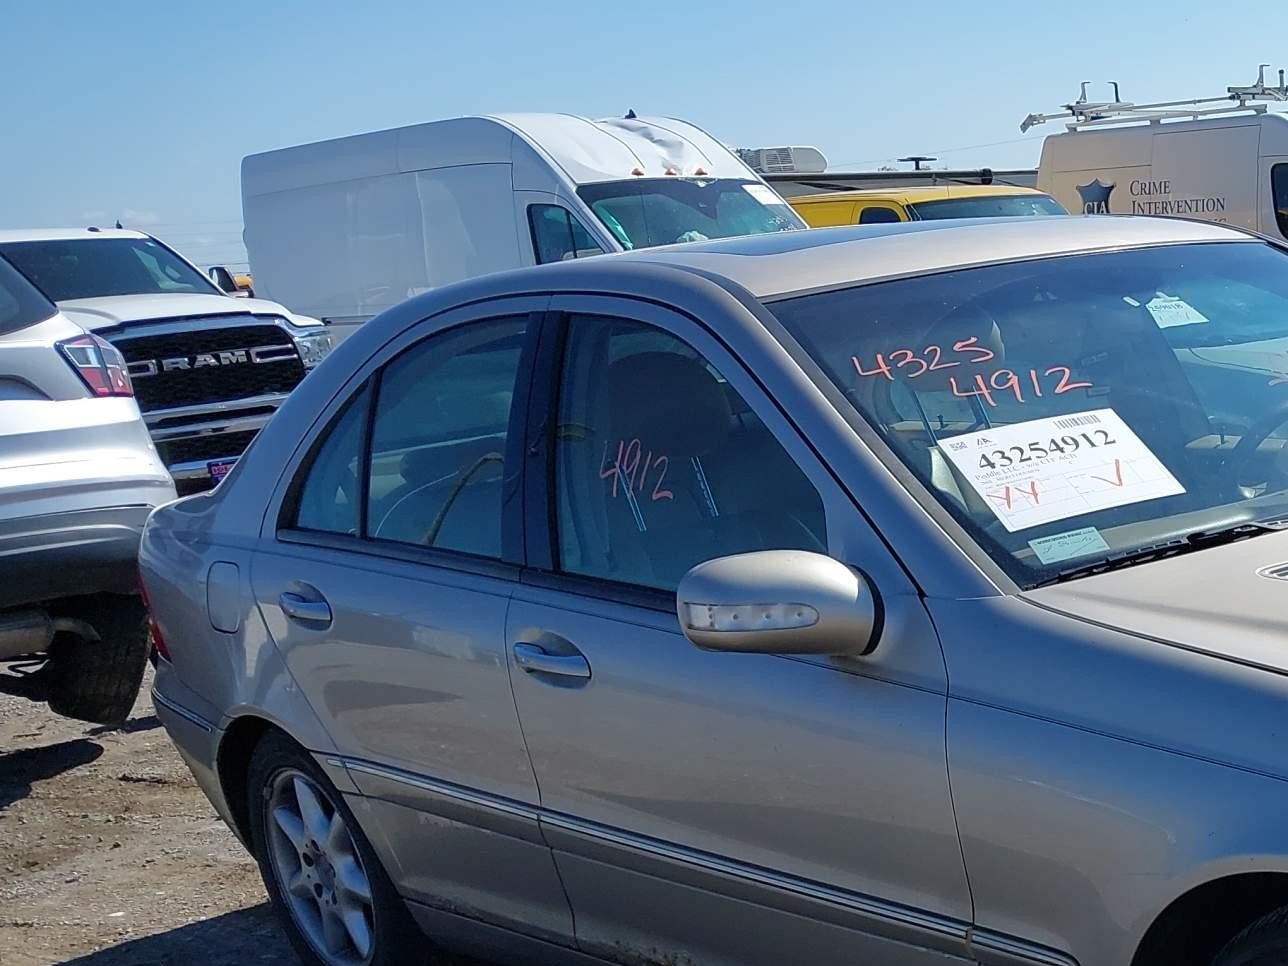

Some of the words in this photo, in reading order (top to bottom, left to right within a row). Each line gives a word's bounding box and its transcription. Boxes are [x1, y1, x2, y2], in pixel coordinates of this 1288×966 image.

[1130, 180, 1171, 196] CRIME
[1084, 200, 1109, 215] CIA
[1131, 197, 1225, 215] INTERVENTION
[162, 350, 247, 371] RAM
[851, 337, 994, 380] 4325
[949, 366, 1093, 407] 4912
[978, 429, 1116, 471] 43254912
[600, 438, 674, 501] 4912
